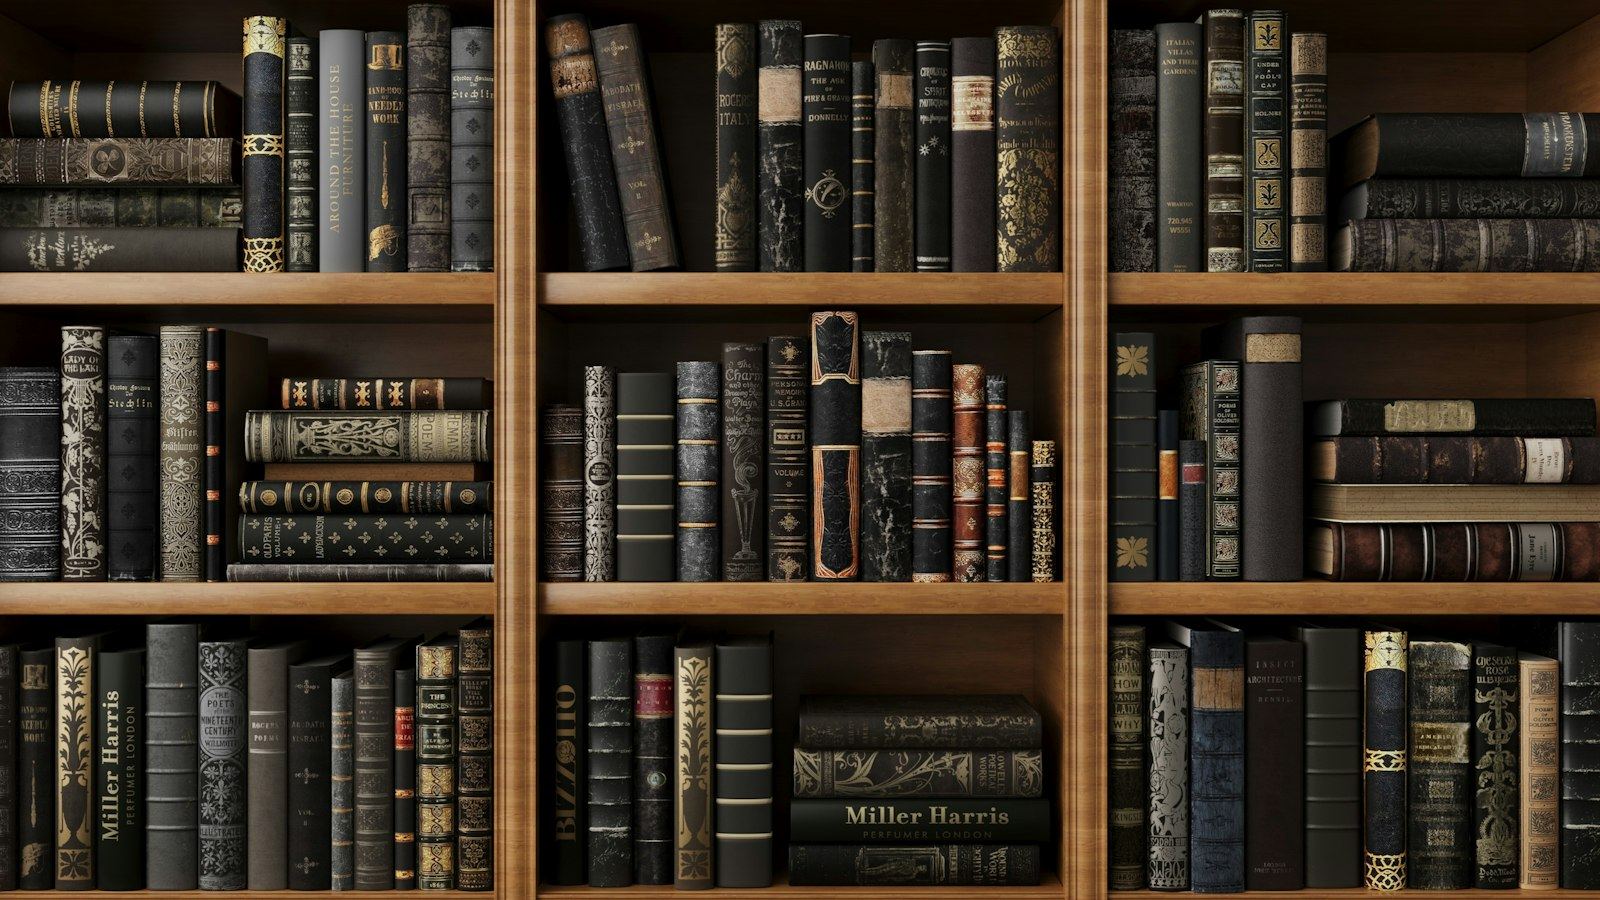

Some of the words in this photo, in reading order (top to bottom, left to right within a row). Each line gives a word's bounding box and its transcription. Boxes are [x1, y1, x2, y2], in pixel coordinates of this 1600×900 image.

[329, 64, 341, 118] HOUSE
[368, 100, 404, 111] NEEDLE
[372, 113, 400, 124] WORK
[719, 112, 752, 126] ITALY
[808, 113, 849, 122] DONNELLY
[329, 124, 341, 158] THE
[1558, 112, 1575, 173] FRANKENSTEIN
[342, 103, 354, 196] FURNITURE
[329, 163, 341, 233] AROUND
[63, 355, 86, 364] LADY
[63, 364, 79, 373] THE
[420, 413, 436, 462] POEMS
[775, 469, 804, 477] VOLUME
[263, 516, 272, 543] PARIS
[1528, 534, 1537, 553] Jane
[263, 543, 272, 559] OLD
[1527, 554, 1537, 571] Eyre
[1485, 666, 1509, 675] ROSE
[1113, 679, 1140, 688] HOW
[1246, 675, 1303, 684] ARCHITECTURE
[214, 691, 229, 699] THE
[429, 693, 446, 701] THE
[1117, 693, 1137, 701] AND
[207, 699, 235, 708] POETS
[101, 690, 120, 765] Harris
[126, 705, 135, 758] LONDON
[204, 726, 237, 736] CENTURY
[1112, 720, 1140, 729] WHY
[253, 734, 280, 742] POEMS
[976, 756, 988, 788] WORKS
[988, 753, 996, 791] POETICAL
[126, 765, 135, 825] PERFUMER
[101, 770, 120, 842] Miller
[845, 805, 923, 825] Miller
[928, 805, 1010, 825] Harris
[863, 831, 929, 839] PERFUMER
[935, 831, 992, 839] LONDON
